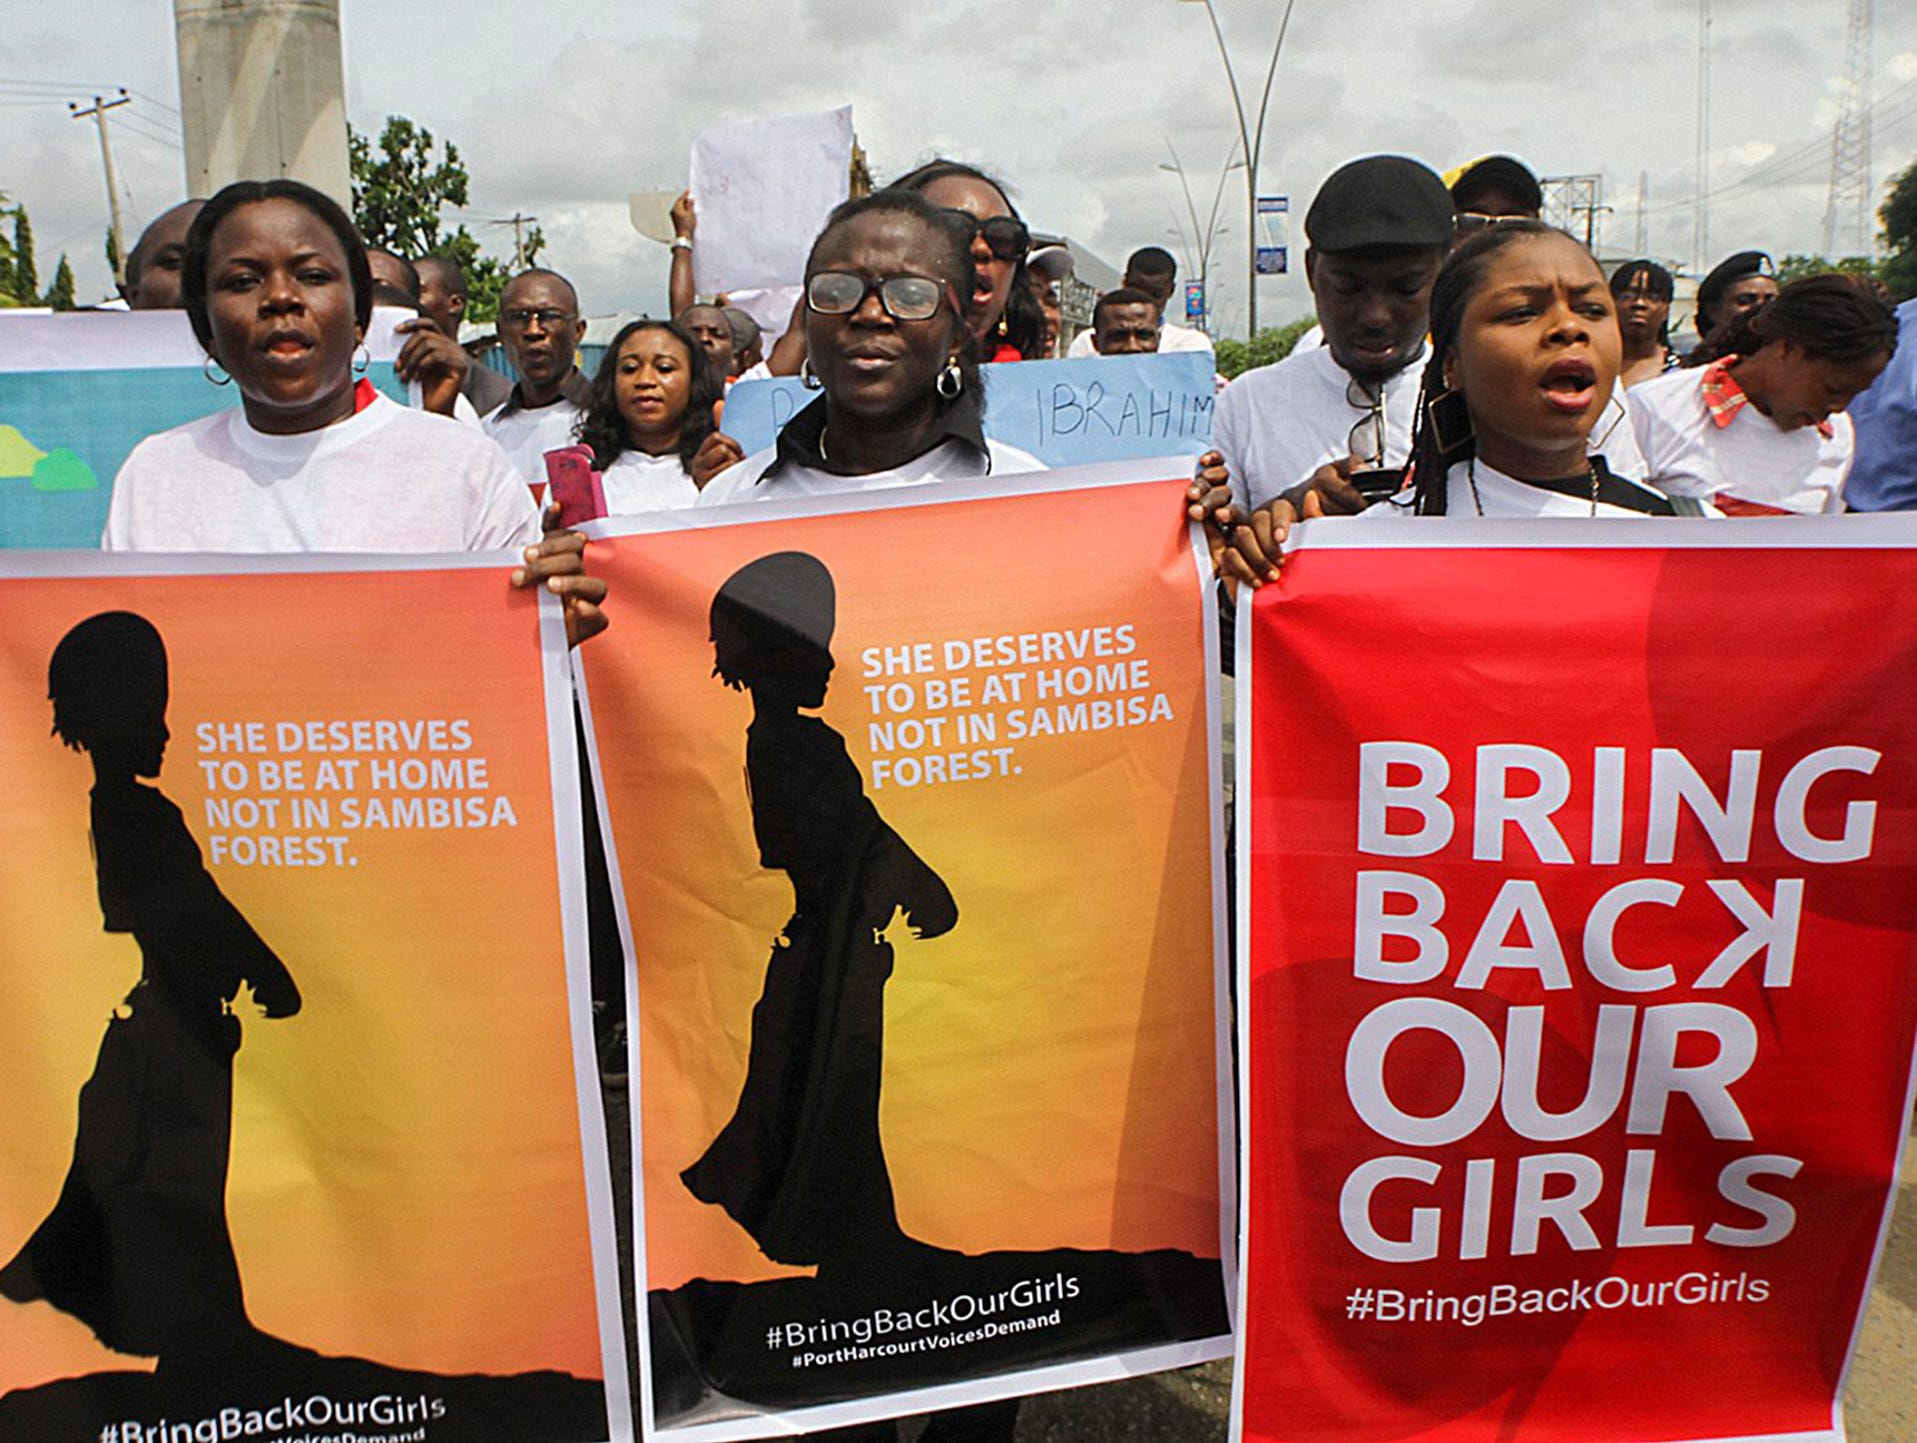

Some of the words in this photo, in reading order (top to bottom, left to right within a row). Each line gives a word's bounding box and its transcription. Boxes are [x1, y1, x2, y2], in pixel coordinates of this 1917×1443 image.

[1036, 381, 1215, 447] IBRAHIM
[861, 643, 935, 679] SHE
[943, 624, 1137, 671] DESERVES
[863, 682, 915, 715] TO
[924, 677, 972, 711] BE
[981, 672, 1027, 705] AT
[1036, 659, 1151, 700] HOME
[195, 721, 267, 753] SHE
[275, 719, 473, 753] DESERVES
[868, 717, 947, 753] NOT
[956, 712, 997, 745] IN
[1005, 693, 1174, 740] SAMBISA
[198, 760, 249, 791] TO
[258, 759, 305, 791] BE
[314, 759, 360, 791] AT
[370, 757, 489, 791] HOME
[871, 747, 1023, 790] FOREST.
[204, 797, 281, 829] NOT
[290, 797, 330, 829] IN
[340, 796, 518, 829] SAMBISA
[1357, 740, 1882, 866] BRING
[209, 835, 358, 867] FOREST.
[1353, 869, 1806, 994] BACK
[1344, 996, 1759, 1148] OUR
[1338, 1148, 1805, 1264] GIRLS
[766, 1273, 1081, 1350] #BringBackOurGirls
[1345, 1271, 1770, 1327] #BringBackOurGirls
[792, 1309, 1062, 1369] #PortHarcourtVoicesDemand
[99, 1394, 447, 1443] #BringBackOurGirls
